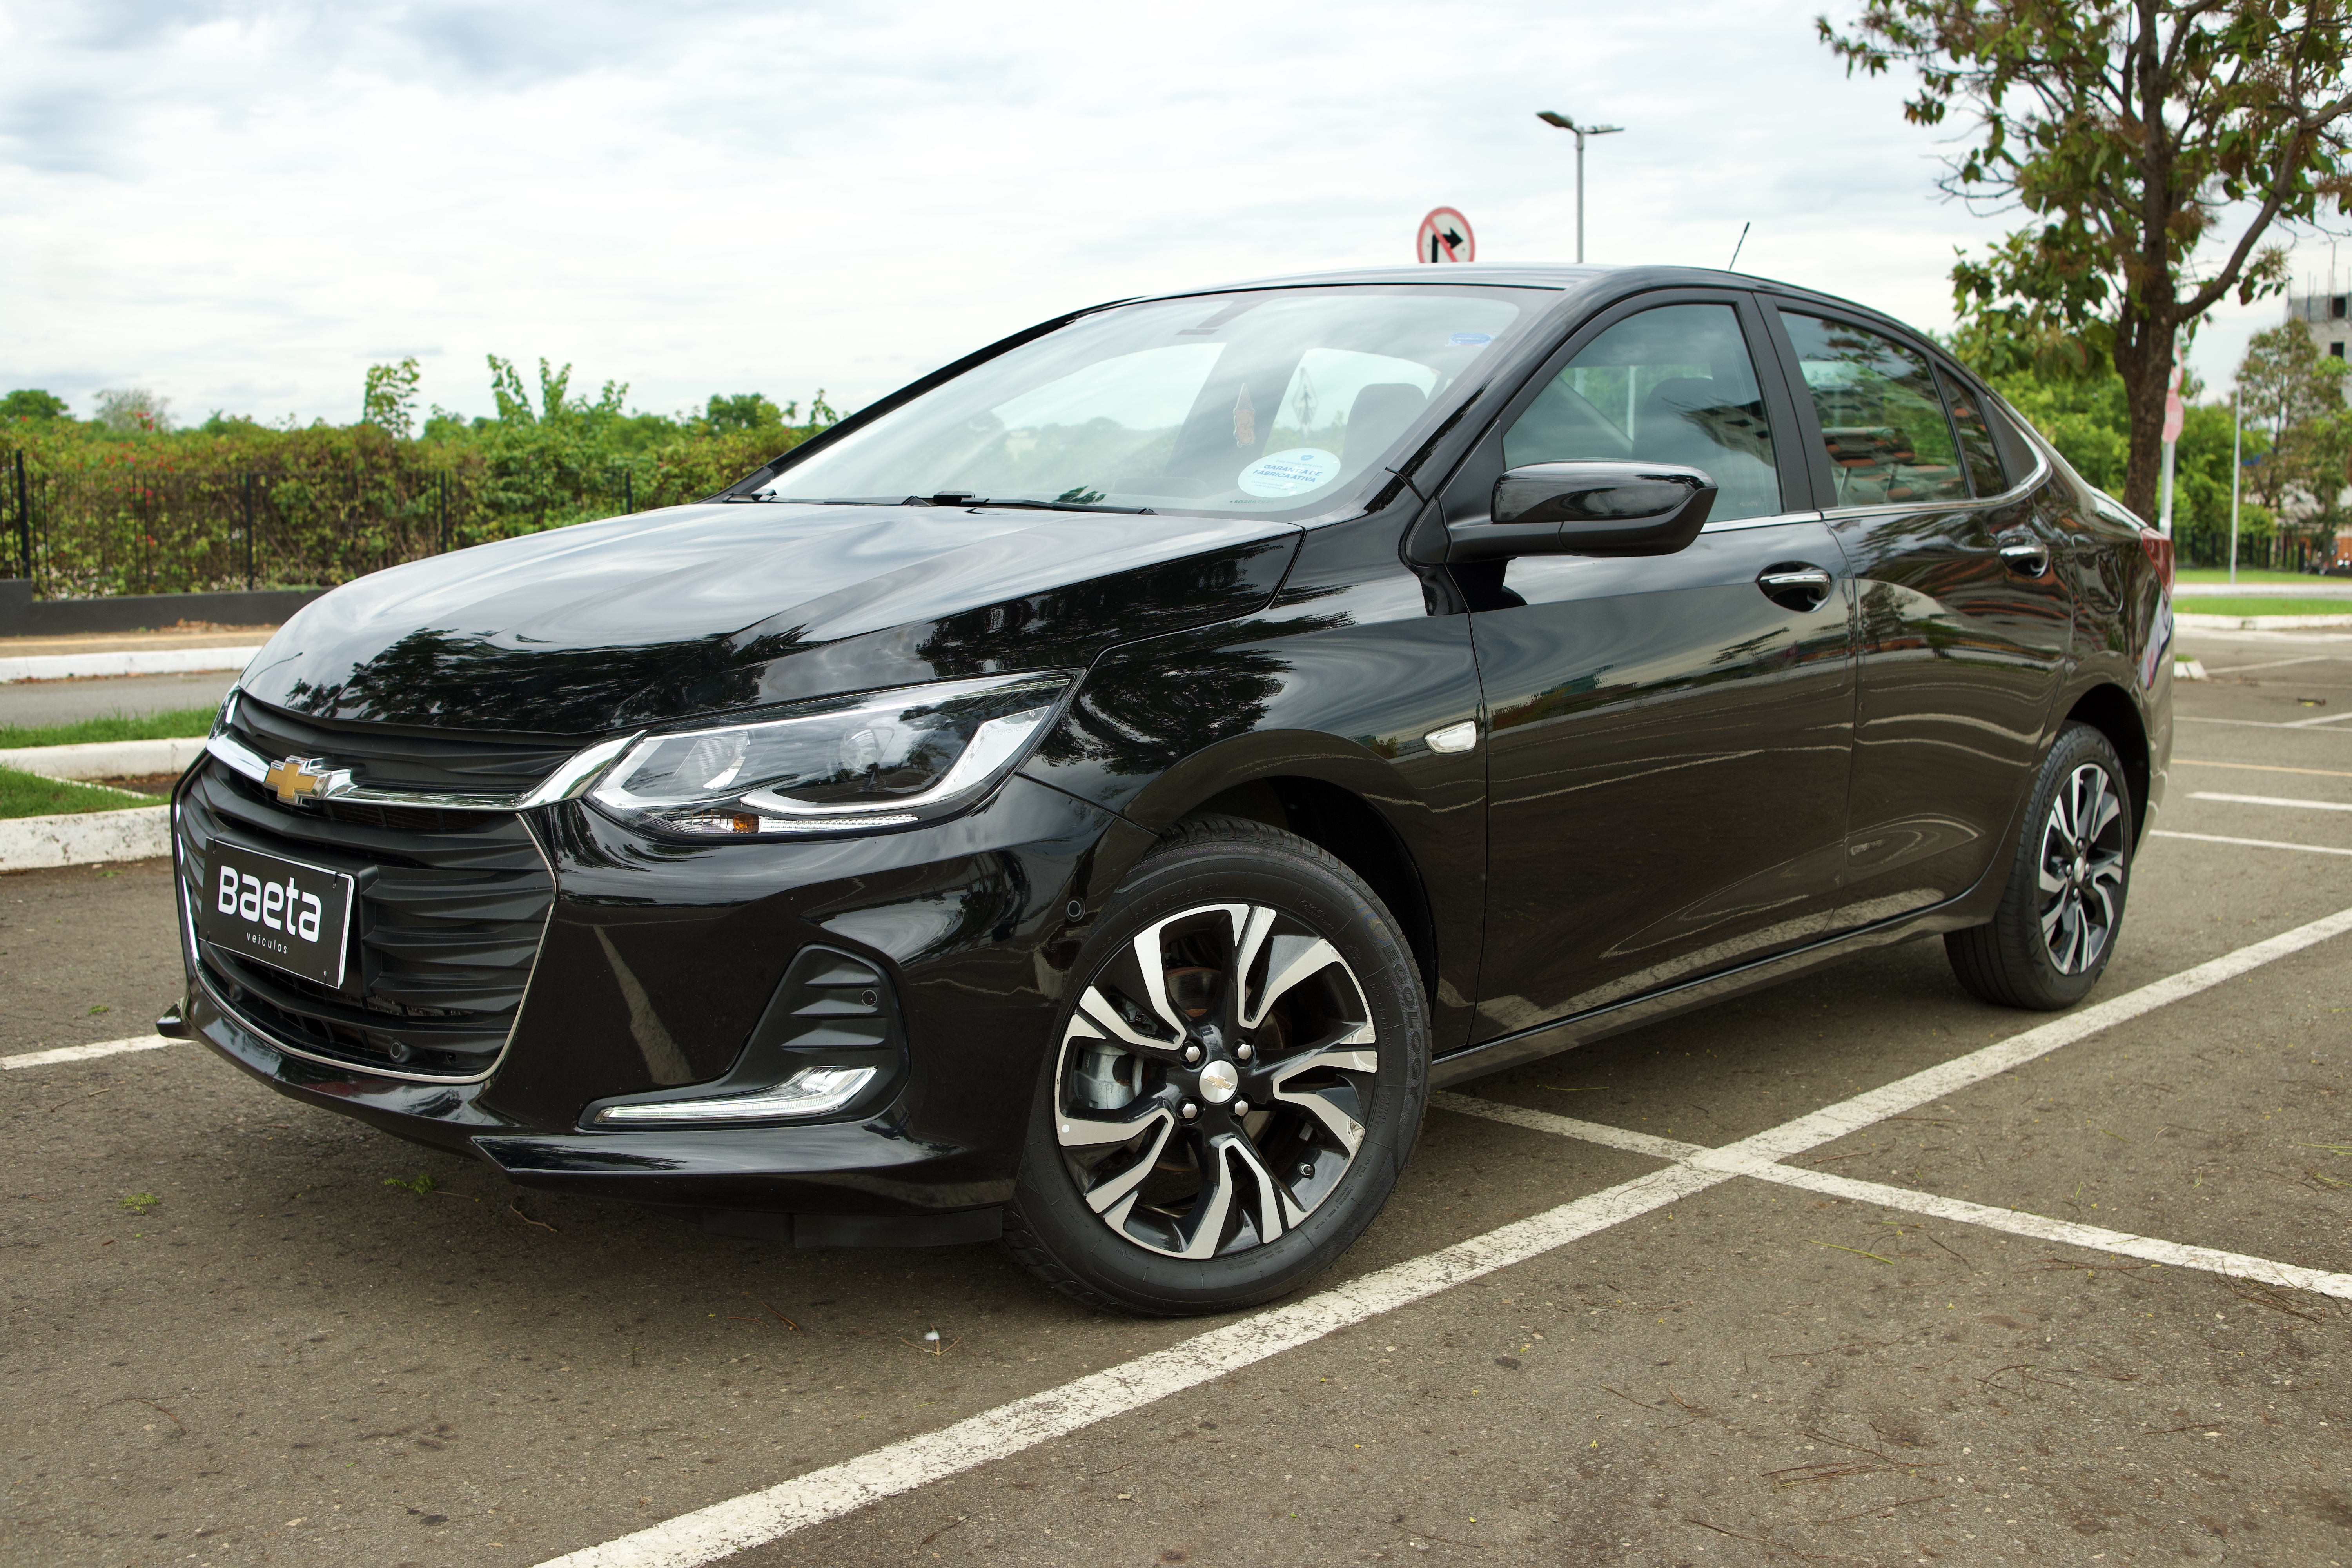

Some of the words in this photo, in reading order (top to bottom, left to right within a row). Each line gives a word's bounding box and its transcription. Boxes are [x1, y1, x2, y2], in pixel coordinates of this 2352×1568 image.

[1253, 470, 1290, 478] FÁBRICA
[1263, 465, 1308, 474] GARANTIA
[998, 724, 1033, 735] CHEVROLET
[218, 865, 321, 942] Baeta
[247, 932, 288, 954] veículos
[1370, 983, 1380, 998] DOT
[1381, 943, 1422, 1105] ECOLOGY
[1372, 1093, 1387, 1135] TUBELESS
[1381, 1093, 1391, 1124] RADIAL
